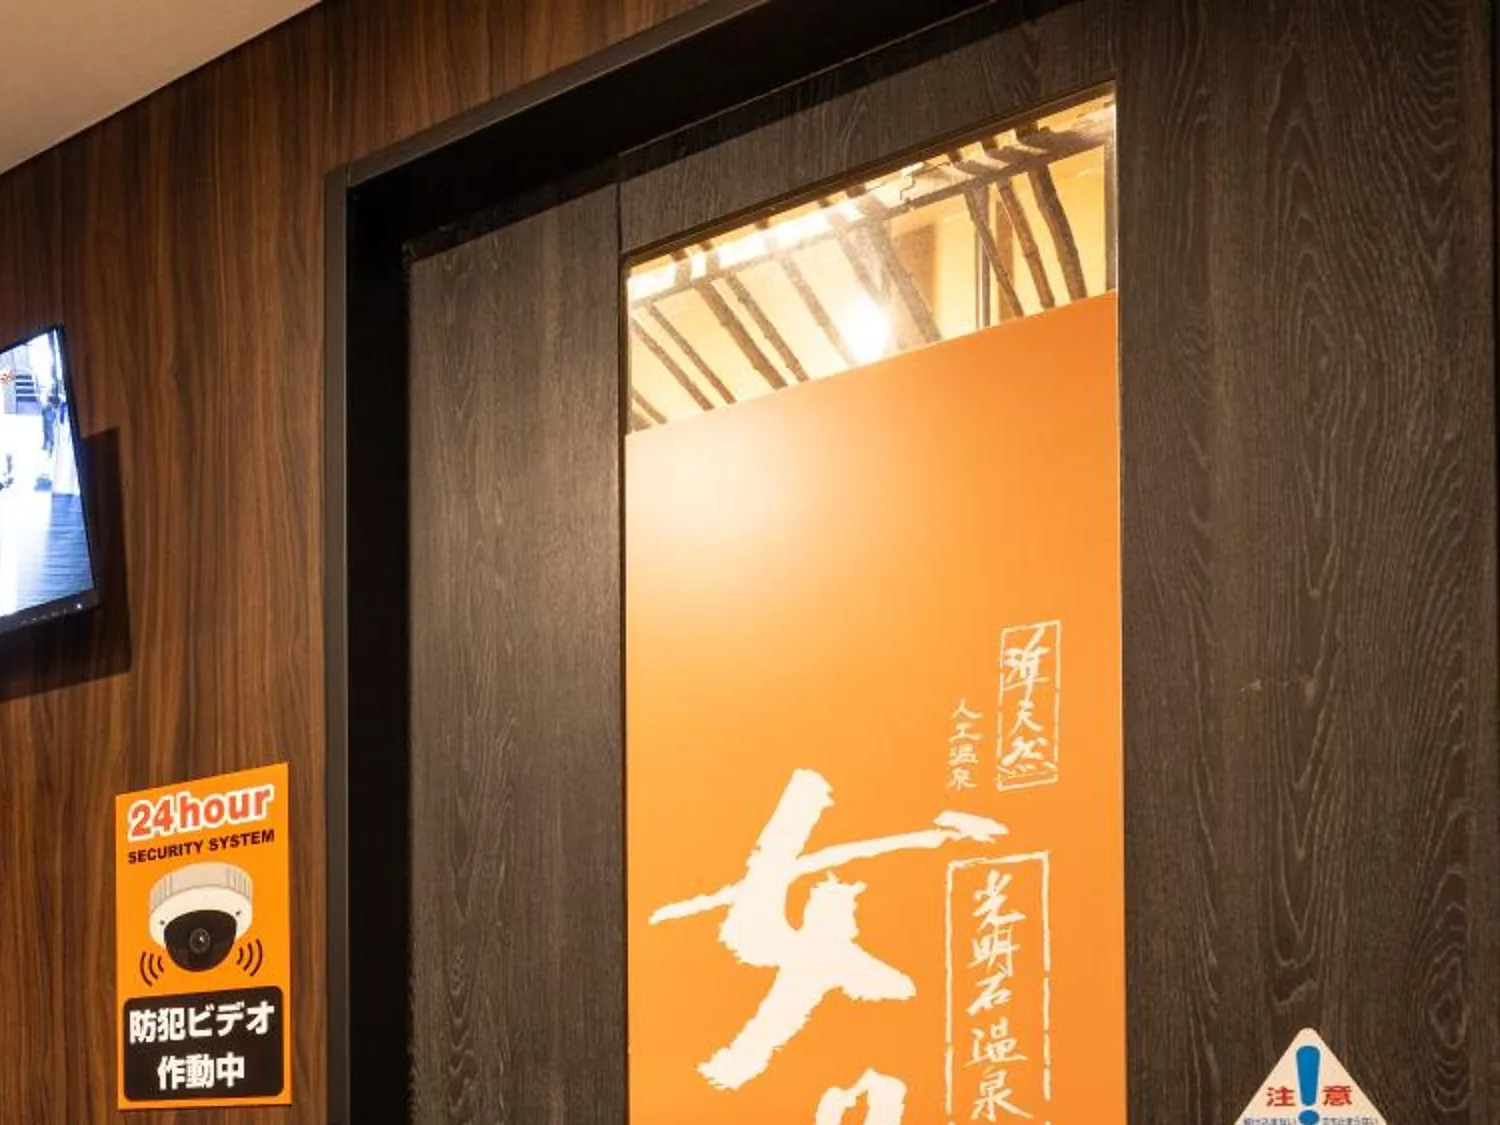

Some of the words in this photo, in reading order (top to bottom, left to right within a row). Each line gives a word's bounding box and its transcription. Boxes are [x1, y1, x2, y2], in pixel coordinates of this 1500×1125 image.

[946, 698, 983, 790] 人工温泉
[127, 840, 203, 864] SECURITY
[209, 828, 275, 851] SYSTEM
[966, 869, 1034, 1123] 光明石温泉
[128, 1000, 276, 1043] 防犯ビデオ
[157, 1051, 245, 1090] 作動中
